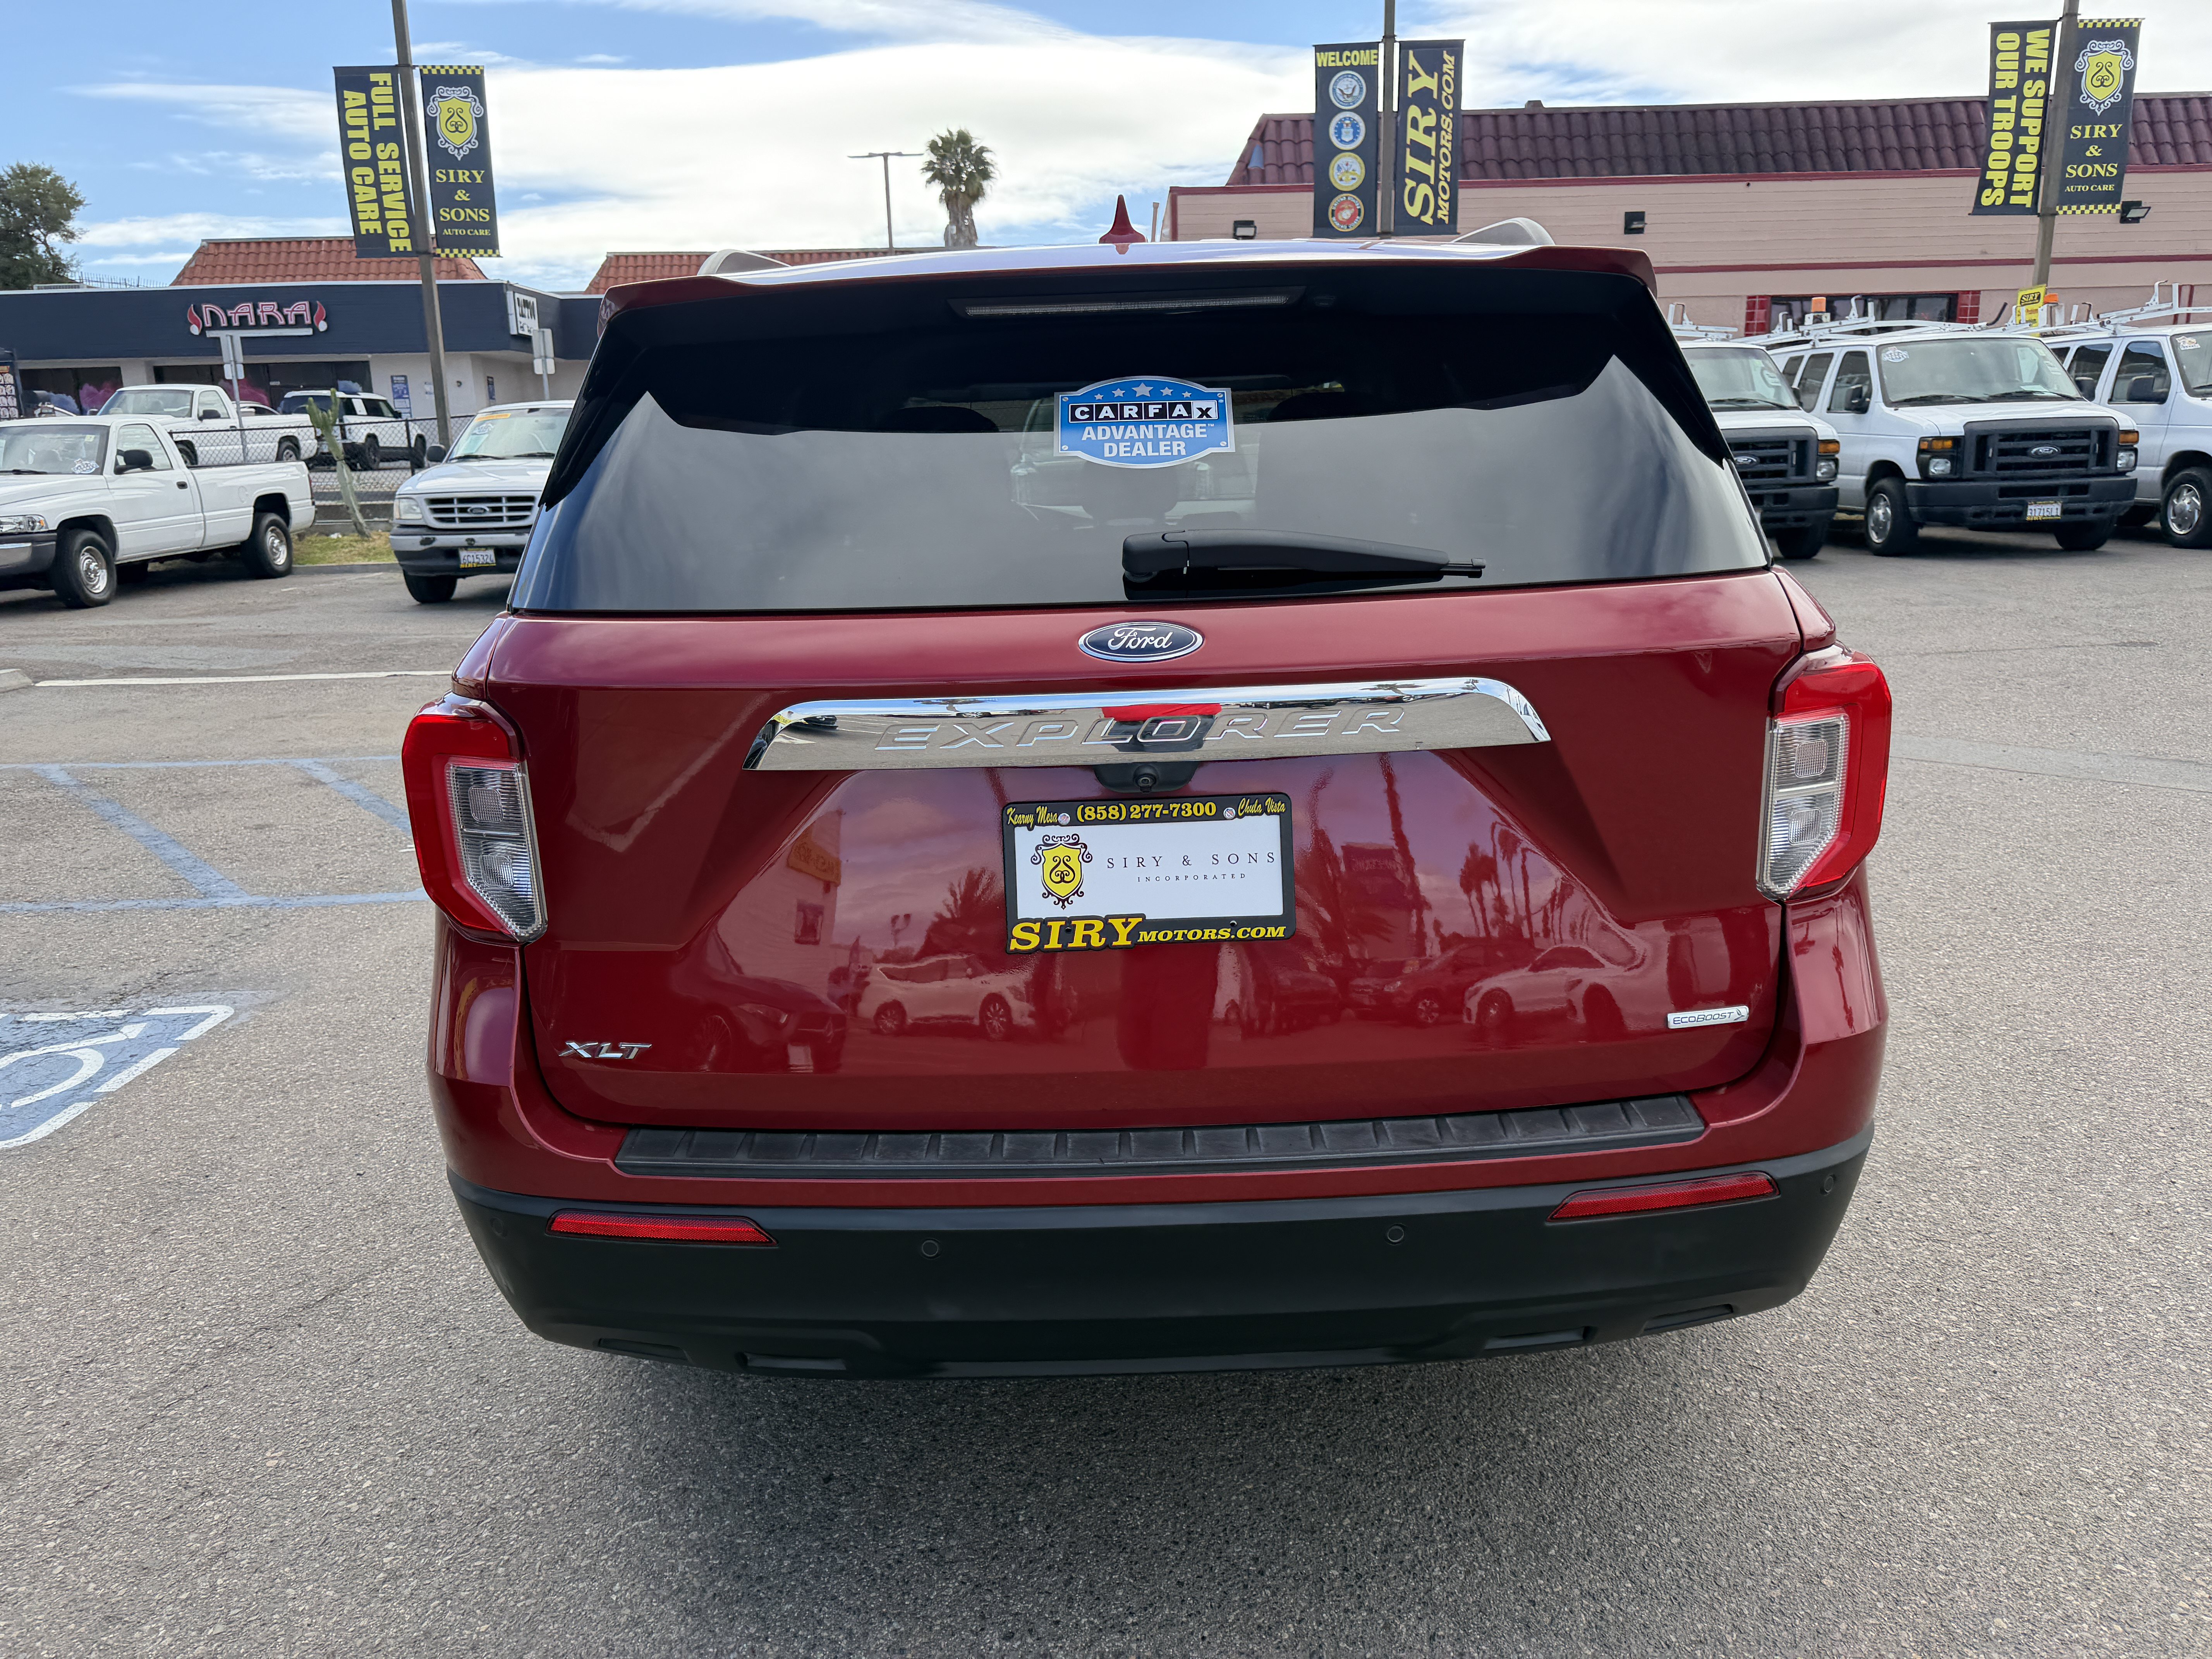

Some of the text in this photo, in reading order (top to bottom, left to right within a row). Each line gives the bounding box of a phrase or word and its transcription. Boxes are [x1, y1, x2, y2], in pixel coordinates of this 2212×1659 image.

[1316, 50, 1378, 67] WELCOME
[1981, 33, 2020, 206] OUR TROOPS
[2009, 29, 2051, 208] WE SUPPORT
[1404, 50, 1438, 226] SIRY
[1437, 50, 1455, 224] MOTORS.COM
[2070, 124, 2122, 139] SIRY
[2086, 145, 2102, 156] &
[343, 90, 383, 235] AUTO CARE
[369, 73, 412, 252] FULL SERVICE
[2066, 163, 2118, 178] SONS
[436, 169, 485, 183] SIRY
[454, 190, 471, 201] &
[440, 208, 490, 222] SONS
[201, 301, 311, 327] NARA
[1075, 404, 1213, 419] CARFAX
[1082, 423, 1207, 441] ADVANTAGE
[1104, 441, 1187, 457] DEALER
[1108, 627, 1173, 650] Ford
[875, 706, 1405, 750] EXPLORER
[1077, 802, 1216, 822] (858) 277-7300
[1238, 797, 1286, 816] Chula Vista
[1007, 805, 1058, 828] Kearny Mesa
[1107, 852, 1274, 869] SIRY & SONS
[1137, 873, 1245, 883] INCORPORATED
[1010, 917, 1286, 951] SIRY MOTORS.COM
[559, 1042, 652, 1059] XLT
